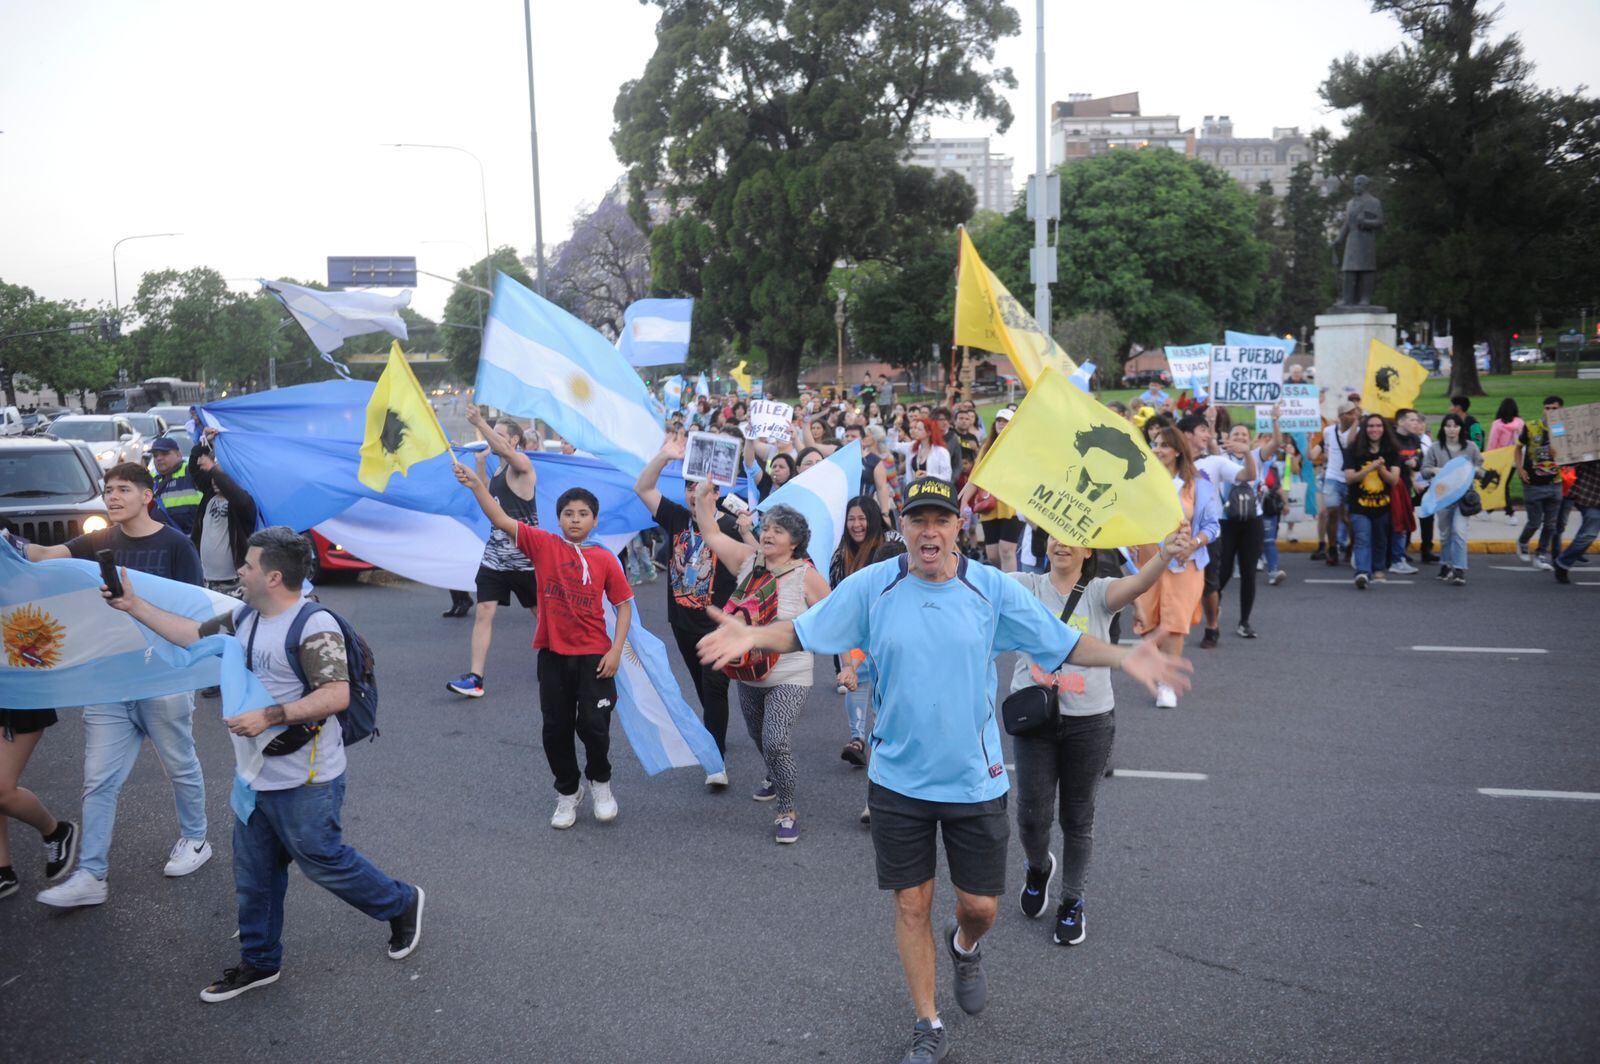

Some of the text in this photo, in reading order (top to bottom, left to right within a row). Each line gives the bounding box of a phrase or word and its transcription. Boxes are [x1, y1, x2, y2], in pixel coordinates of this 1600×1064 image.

[1214, 347, 1284, 364] EL PUEBLO
[1232, 366, 1268, 381] GRITA
[1214, 379, 1281, 401] LIBERTAD
[1280, 386, 1309, 396] SSA
[921, 485, 950, 498] MILEI
[1058, 490, 1091, 515] JAVIER
[1028, 498, 1090, 546] PRESIDENTE
[1033, 484, 1102, 539] MILEI
[545, 583, 595, 607] ADVETURE
